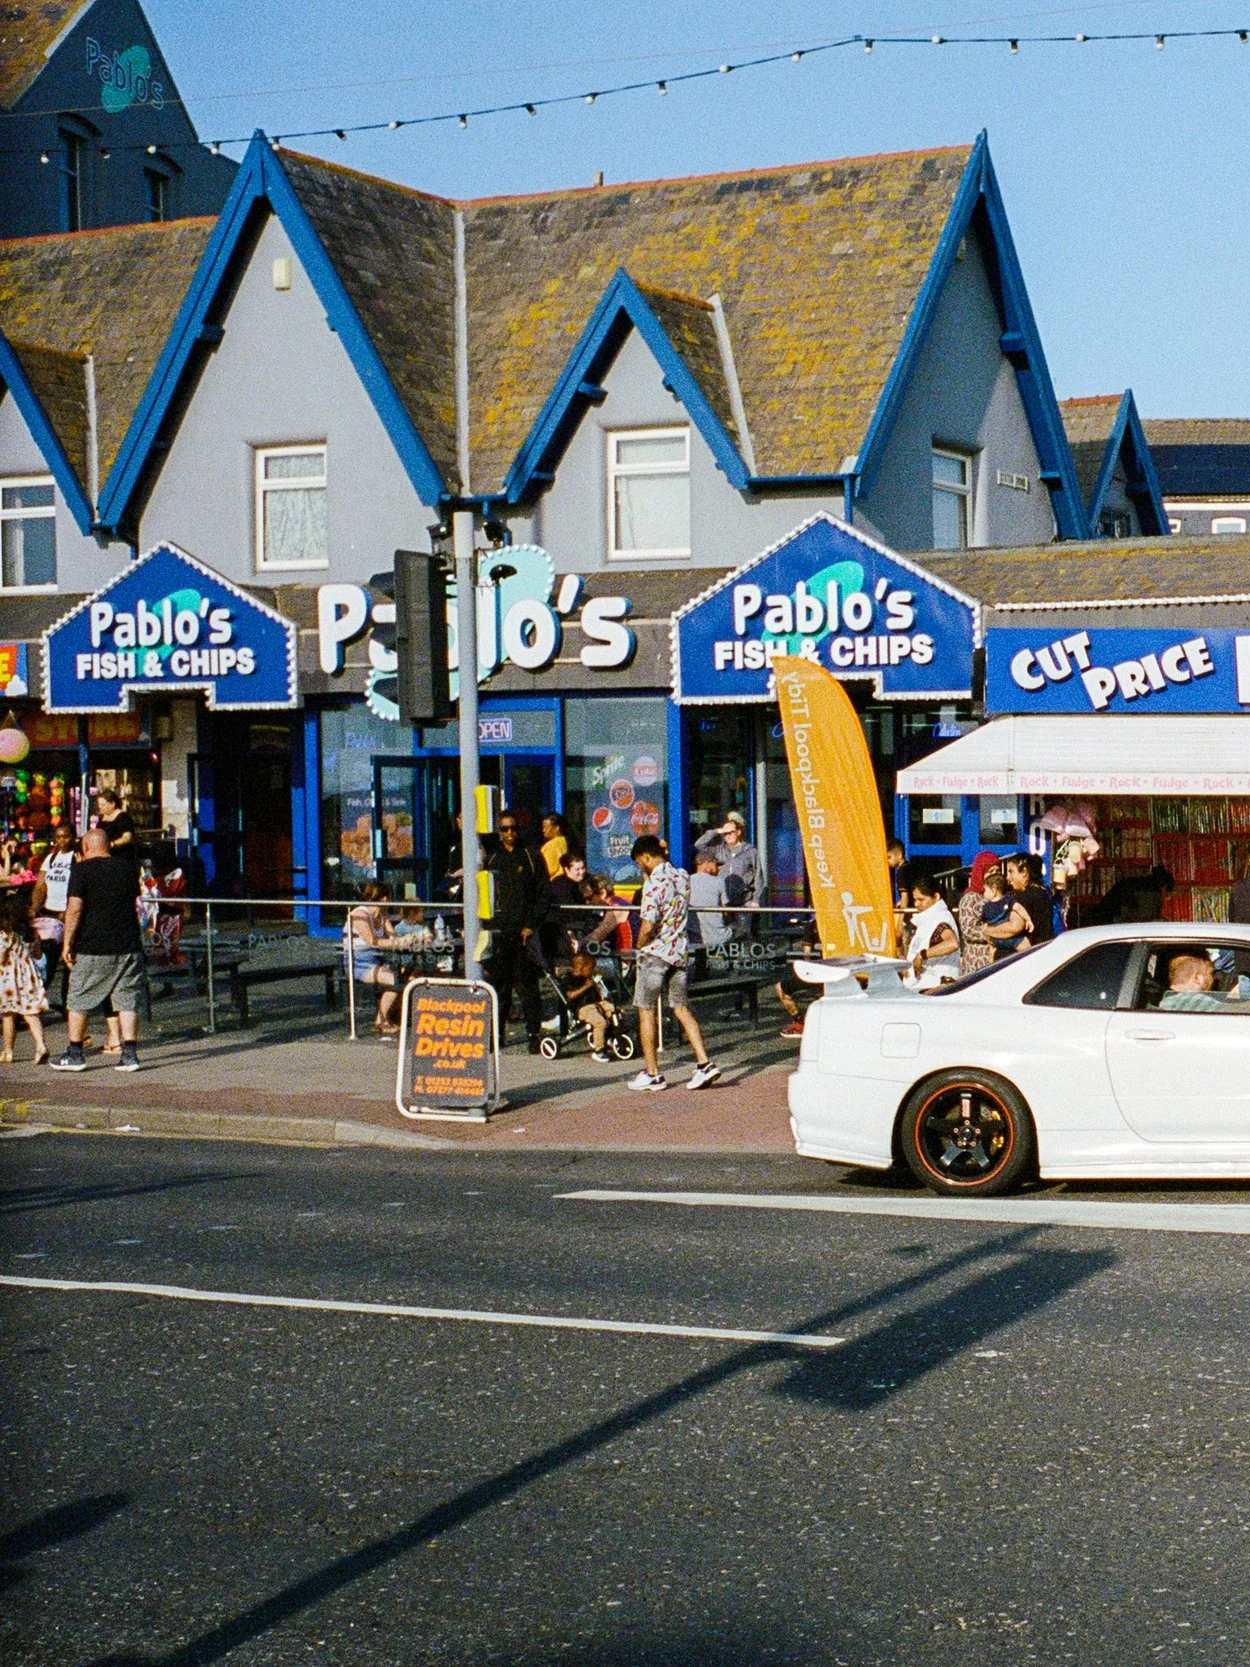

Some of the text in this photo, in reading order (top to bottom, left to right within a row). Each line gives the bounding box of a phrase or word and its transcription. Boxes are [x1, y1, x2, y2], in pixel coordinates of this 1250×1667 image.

[90, 597, 233, 648] Pablo's
[318, 574, 633, 674] Plo's
[733, 577, 914, 636] Pablo's
[76, 648, 256, 680] FISH & CHIPS
[714, 640, 787, 671] FISH
[830, 633, 934, 668] CHIPS
[1011, 631, 1093, 691] CUT
[1081, 637, 1215, 710] PRICE
[1019, 775, 1050, 789] Rock
[1061, 776, 1095, 790] Fudge
[1109, 775, 1141, 789] Rock
[1153, 775, 1189, 790] Fudge
[1203, 777, 1233, 790] Rock
[416, 1013, 485, 1037] Resin
[417, 998, 486, 1014] Blackpool
[415, 1037, 484, 1059] Drives
